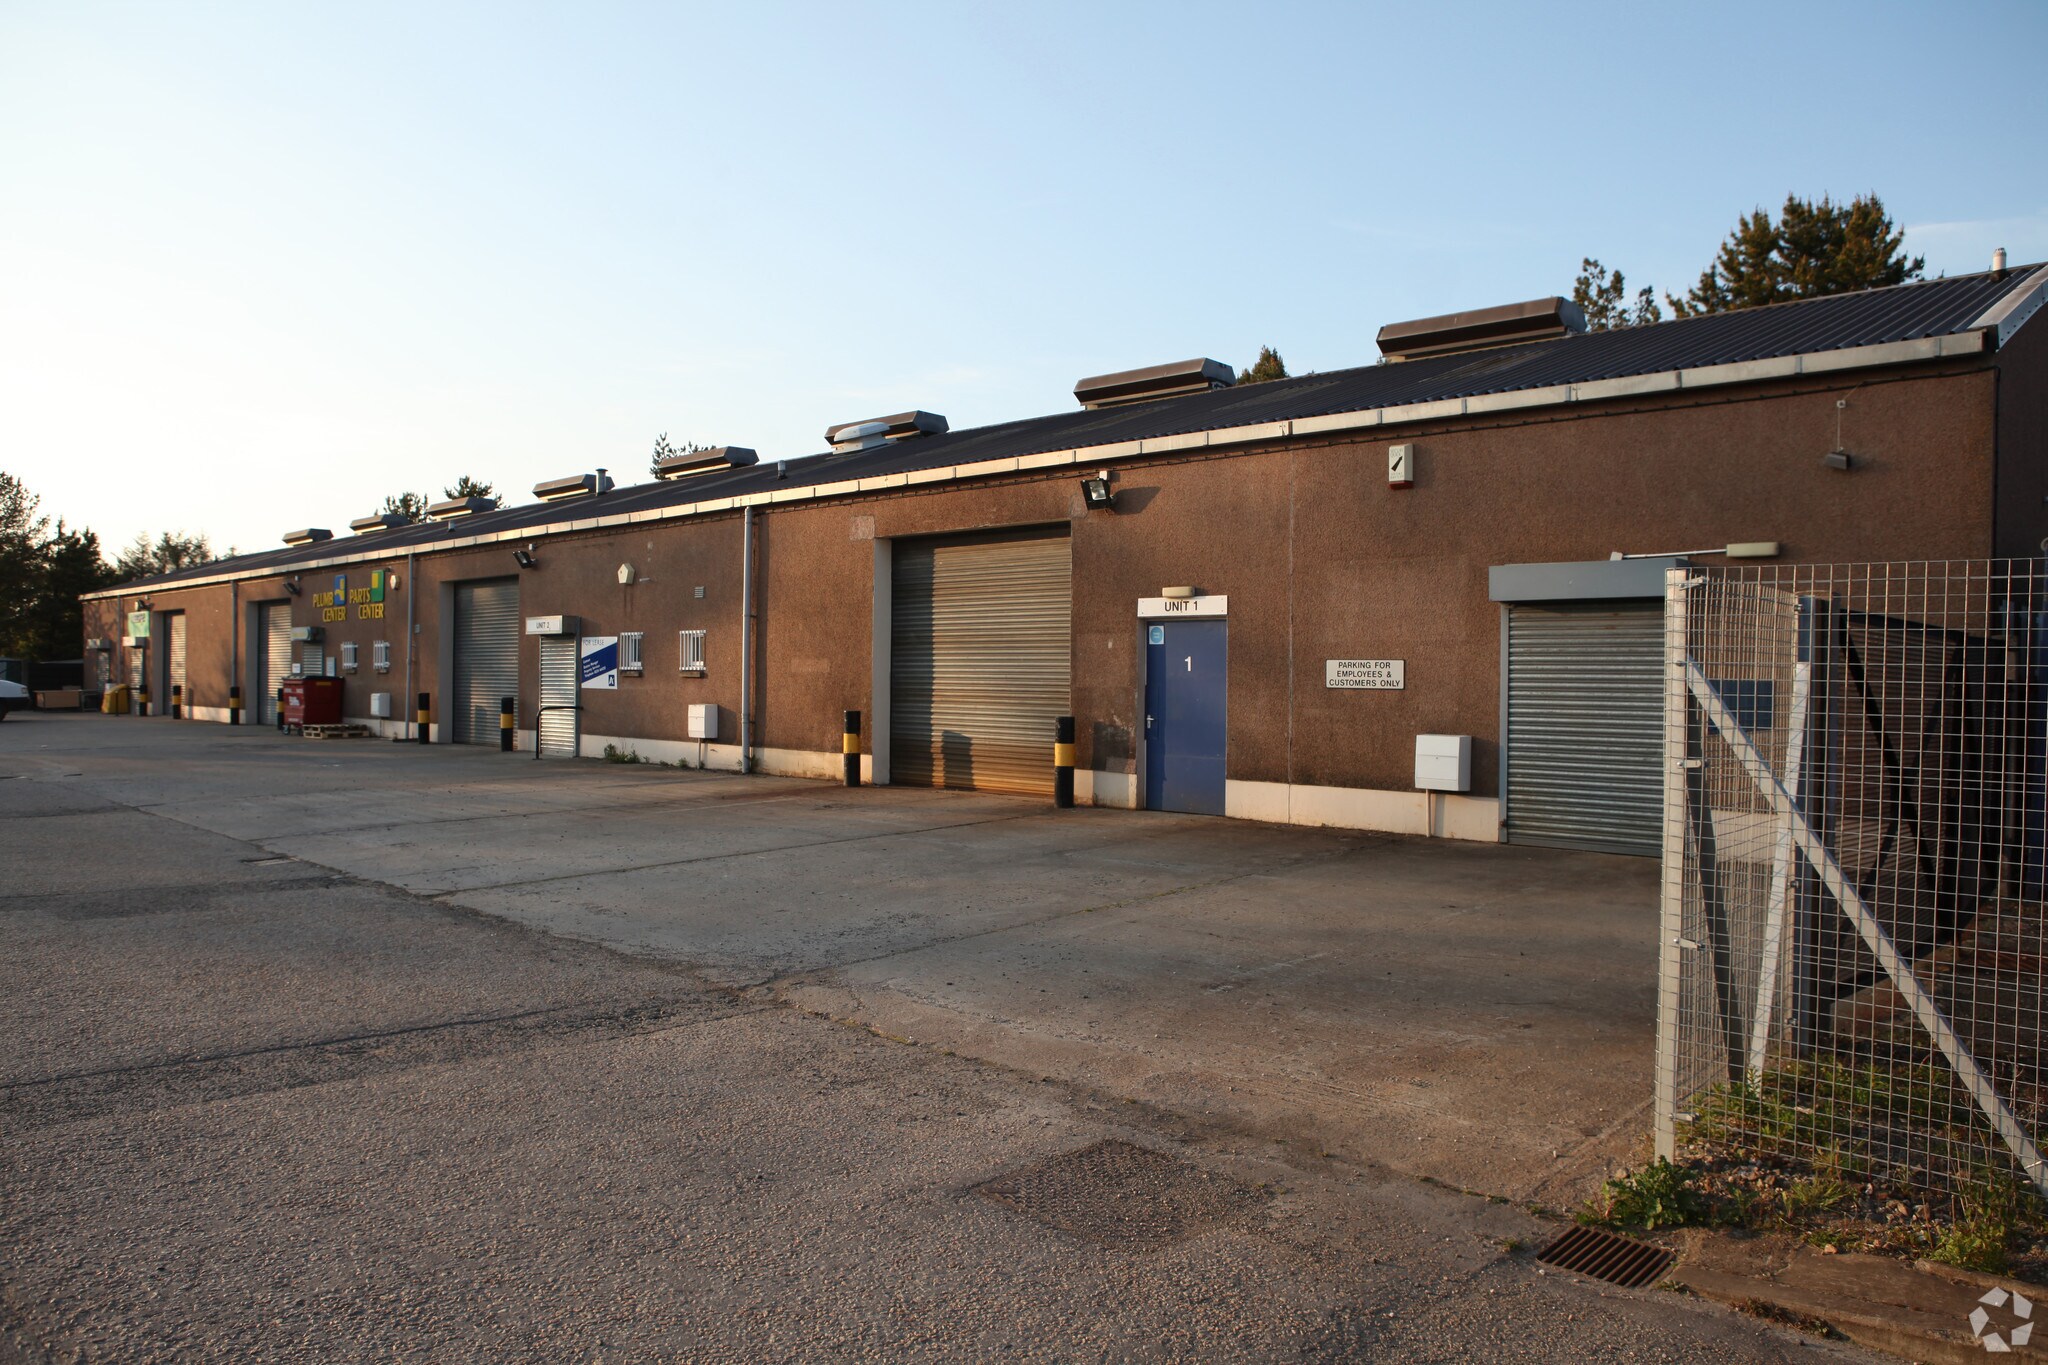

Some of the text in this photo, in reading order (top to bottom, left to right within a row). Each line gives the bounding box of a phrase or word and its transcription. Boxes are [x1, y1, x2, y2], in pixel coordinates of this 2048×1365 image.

[313, 591, 334, 607] PLUMB
[349, 588, 370, 604] PARTS
[323, 606, 346, 622] CENTER
[359, 603, 384, 619] CENTER
[1164, 601, 1198, 612] UNIT 1
[1184, 656, 1192, 672] 1
[1338, 661, 1391, 669] PARKING FOR
[1336, 670, 1383, 678] EMPLOYEES
[1328, 679, 1401, 687] CUSTOMERS ONLY
